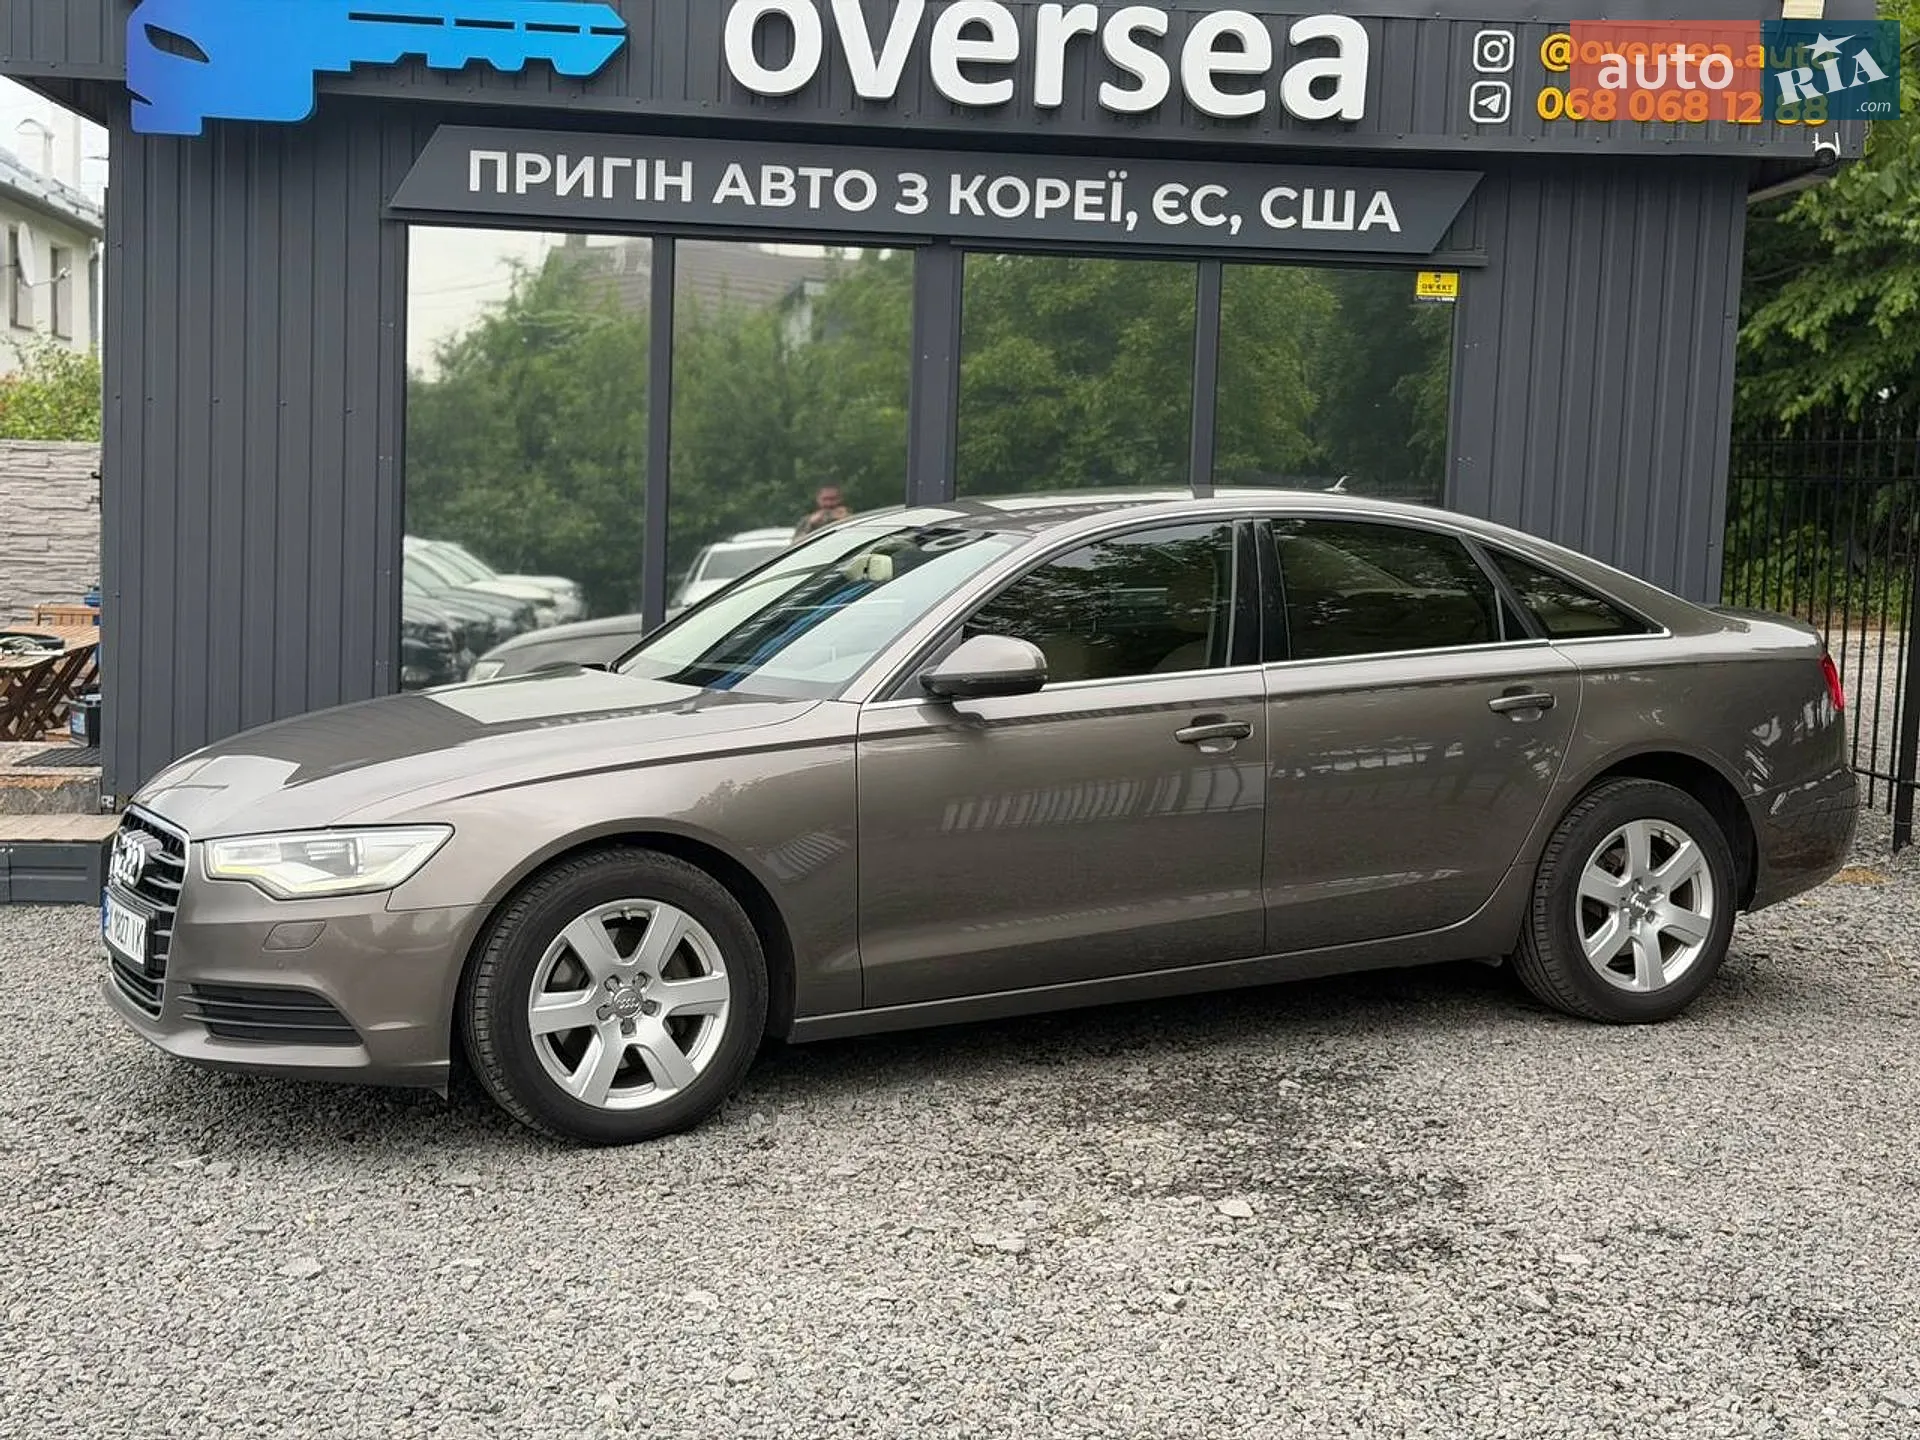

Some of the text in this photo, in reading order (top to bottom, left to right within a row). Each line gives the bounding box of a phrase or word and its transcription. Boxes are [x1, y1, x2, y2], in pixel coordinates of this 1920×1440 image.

[724, 0, 1370, 121] oversea
[1537, 86, 1828, 126] 068 068 12 88
[469, 149, 1401, 235] ПРИГІН АВТО З КОРЕЇ, ЄС, США
